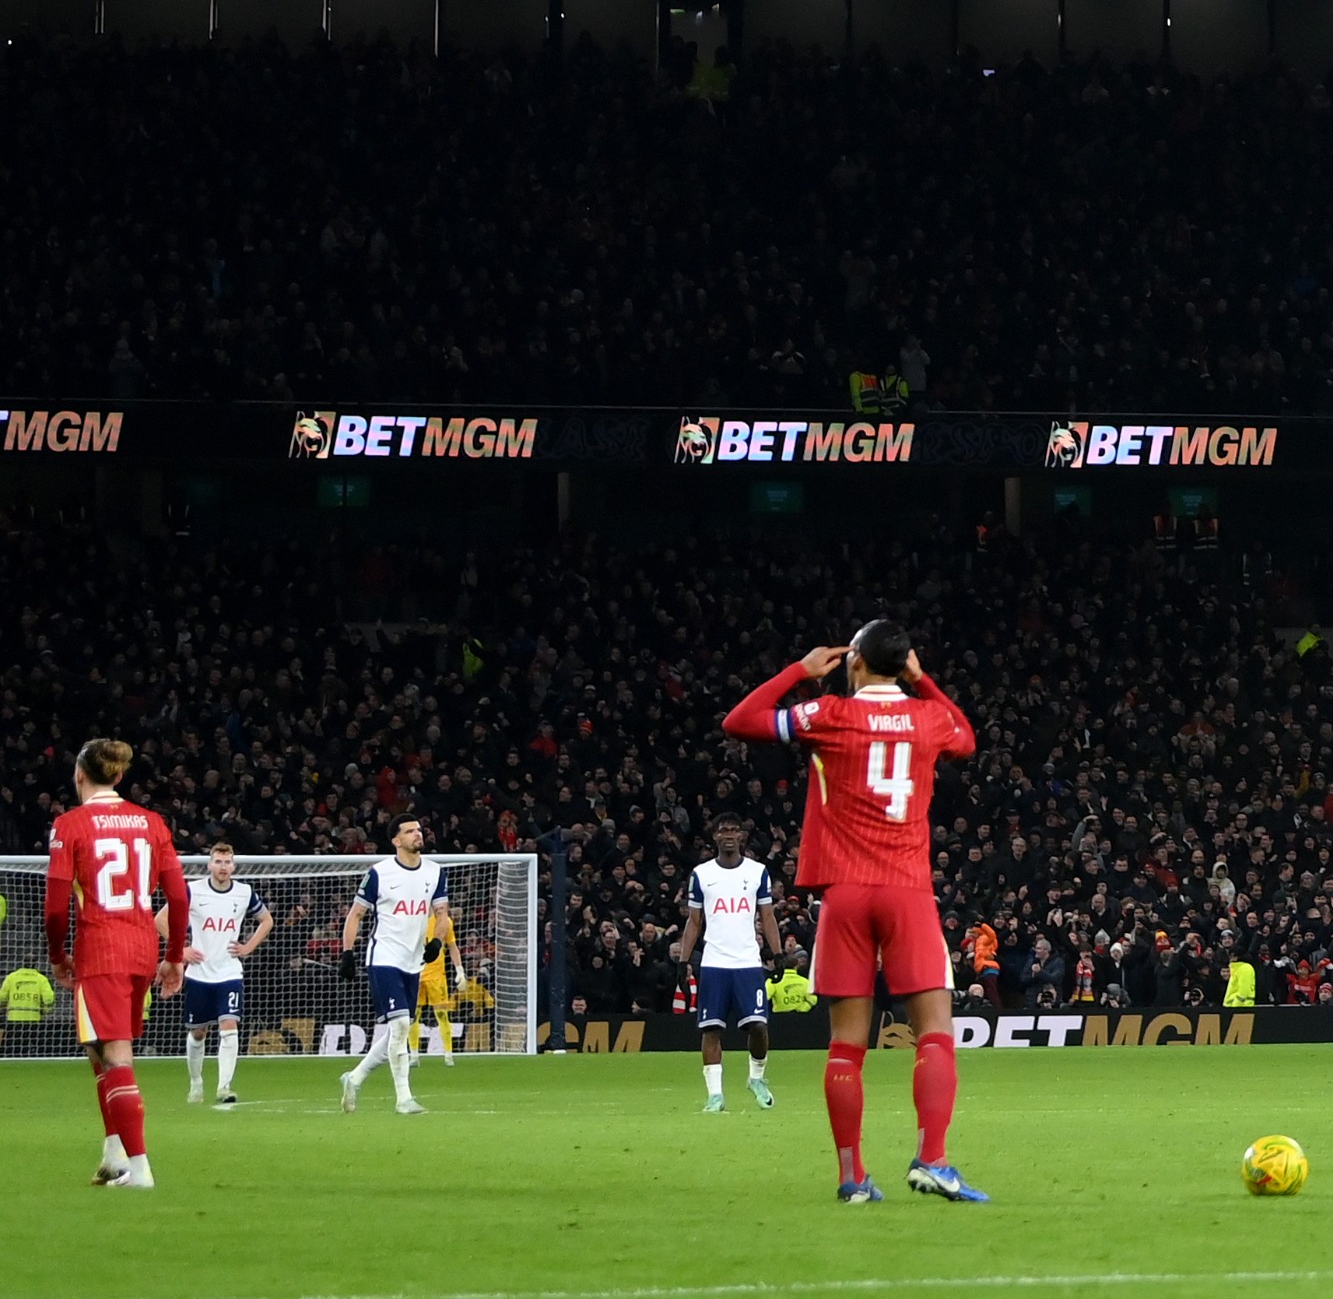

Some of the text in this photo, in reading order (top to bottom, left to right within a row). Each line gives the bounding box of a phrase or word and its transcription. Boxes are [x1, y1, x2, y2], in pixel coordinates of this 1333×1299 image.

[334, 416, 537, 457] BETMGM
[717, 417, 914, 463] BETMGM
[1087, 426, 1277, 465] BETMGM
[867, 714, 914, 732] VIRGIL
[867, 741, 914, 822] 4
[92, 815, 148, 829] TSIMIKAS
[95, 838, 153, 910] 21
[392, 899, 427, 916] AIA
[713, 897, 750, 914] AIA
[202, 916, 236, 932] AIA
[228, 991, 239, 1008] 21
[756, 989, 764, 1007] 8
